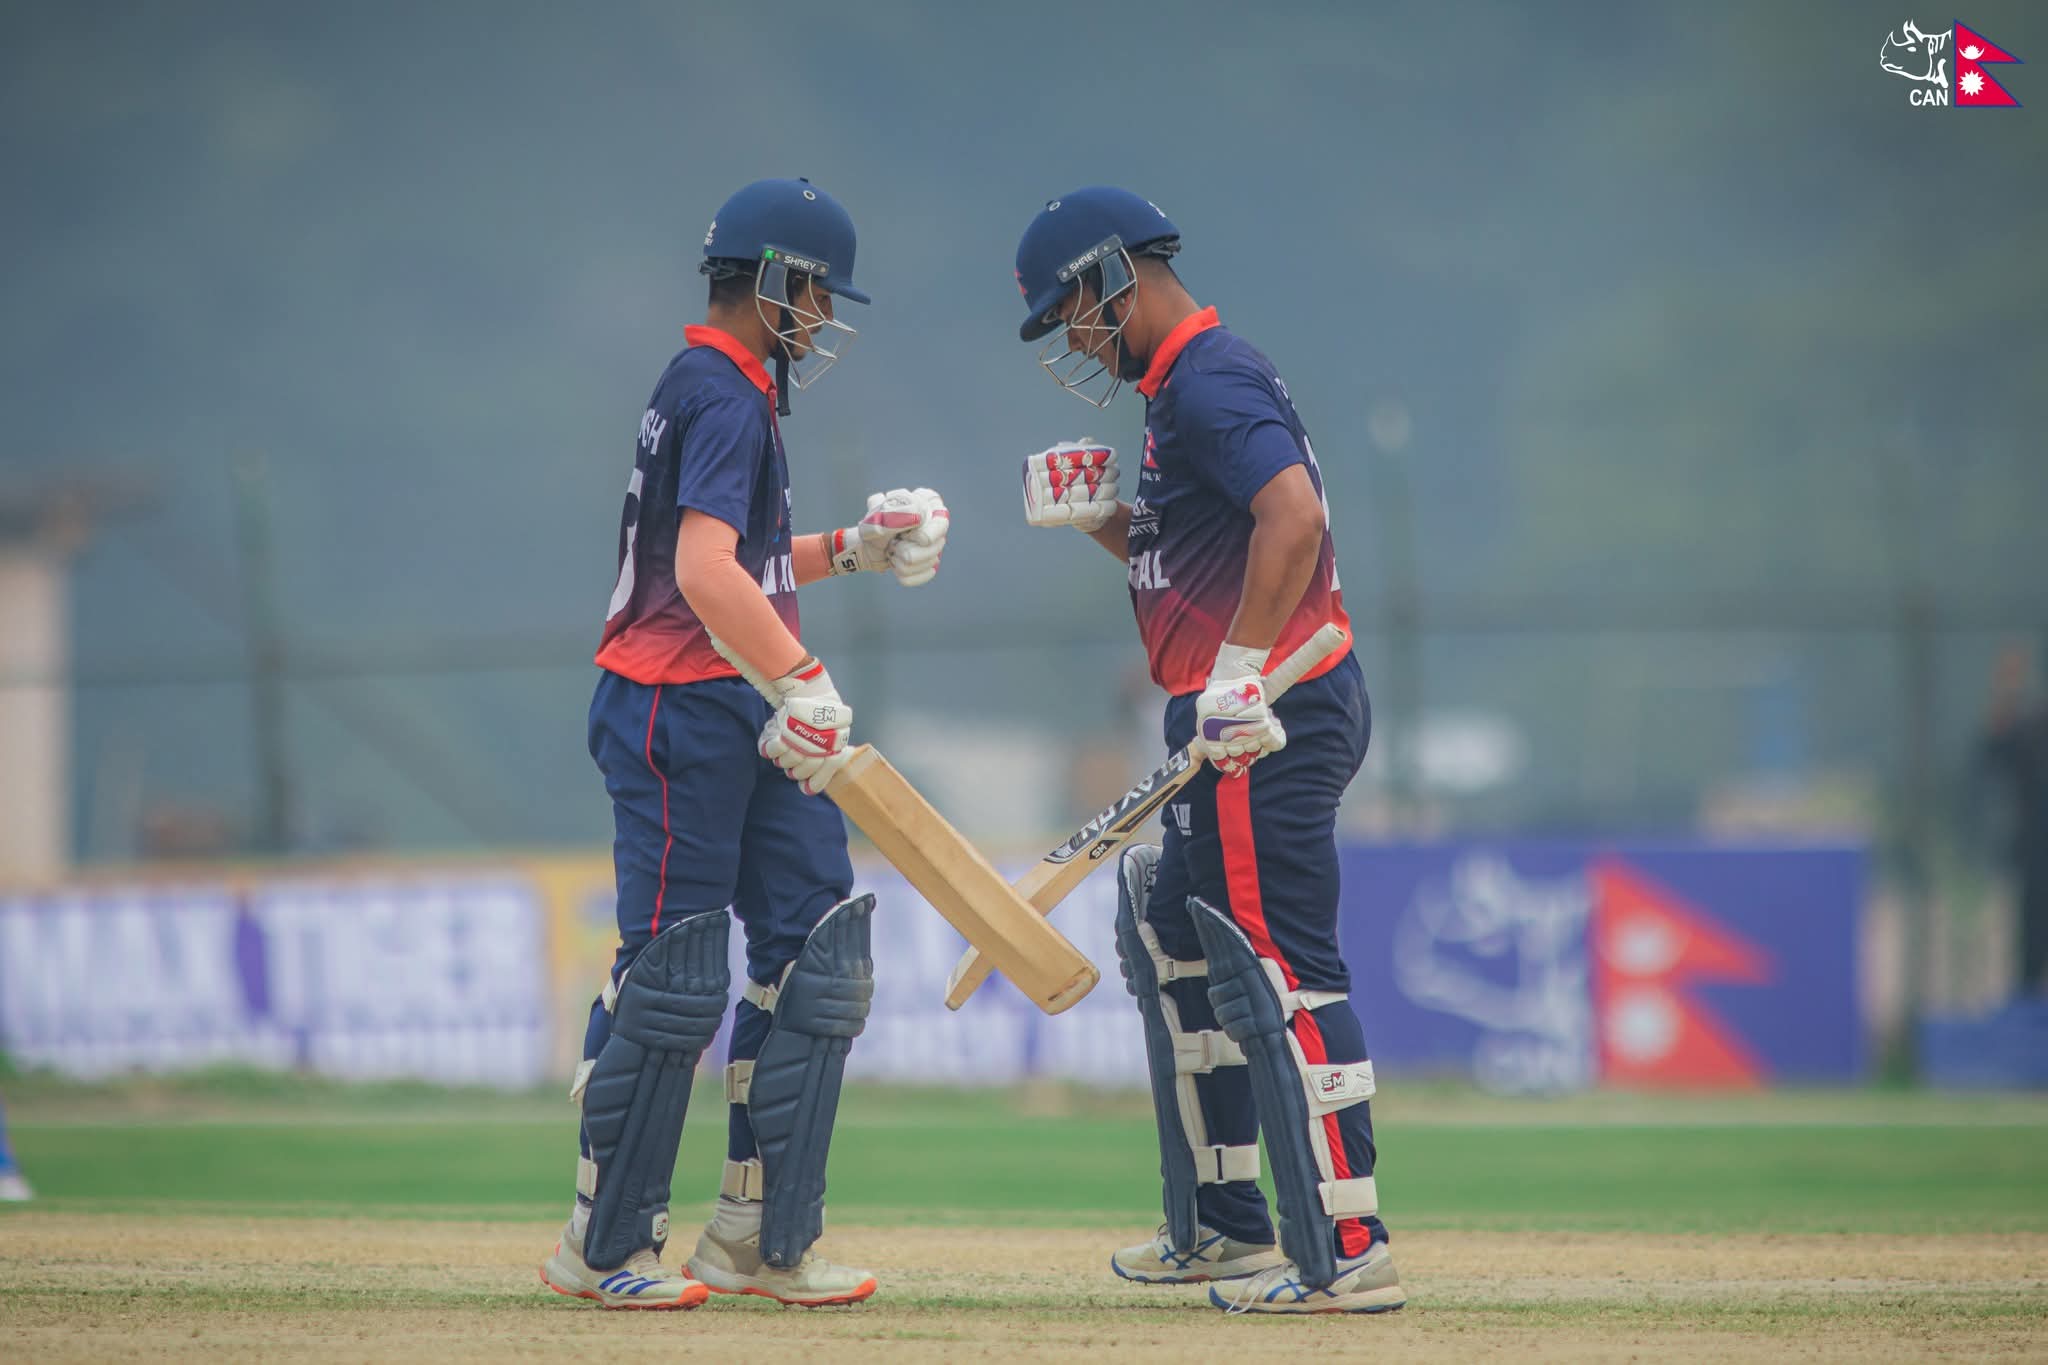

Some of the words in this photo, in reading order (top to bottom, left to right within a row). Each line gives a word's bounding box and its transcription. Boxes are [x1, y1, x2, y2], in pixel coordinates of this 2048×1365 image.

[783, 254, 817, 272] SHREY
[1068, 247, 1099, 273] SHREY
[1216, 689, 1238, 711] SM
[813, 706, 837, 724] SM
[794, 725, 813, 739] Play
[812, 733, 829, 745] On!
[1091, 842, 1108, 860] SM
[1321, 1071, 1345, 1093] SM
